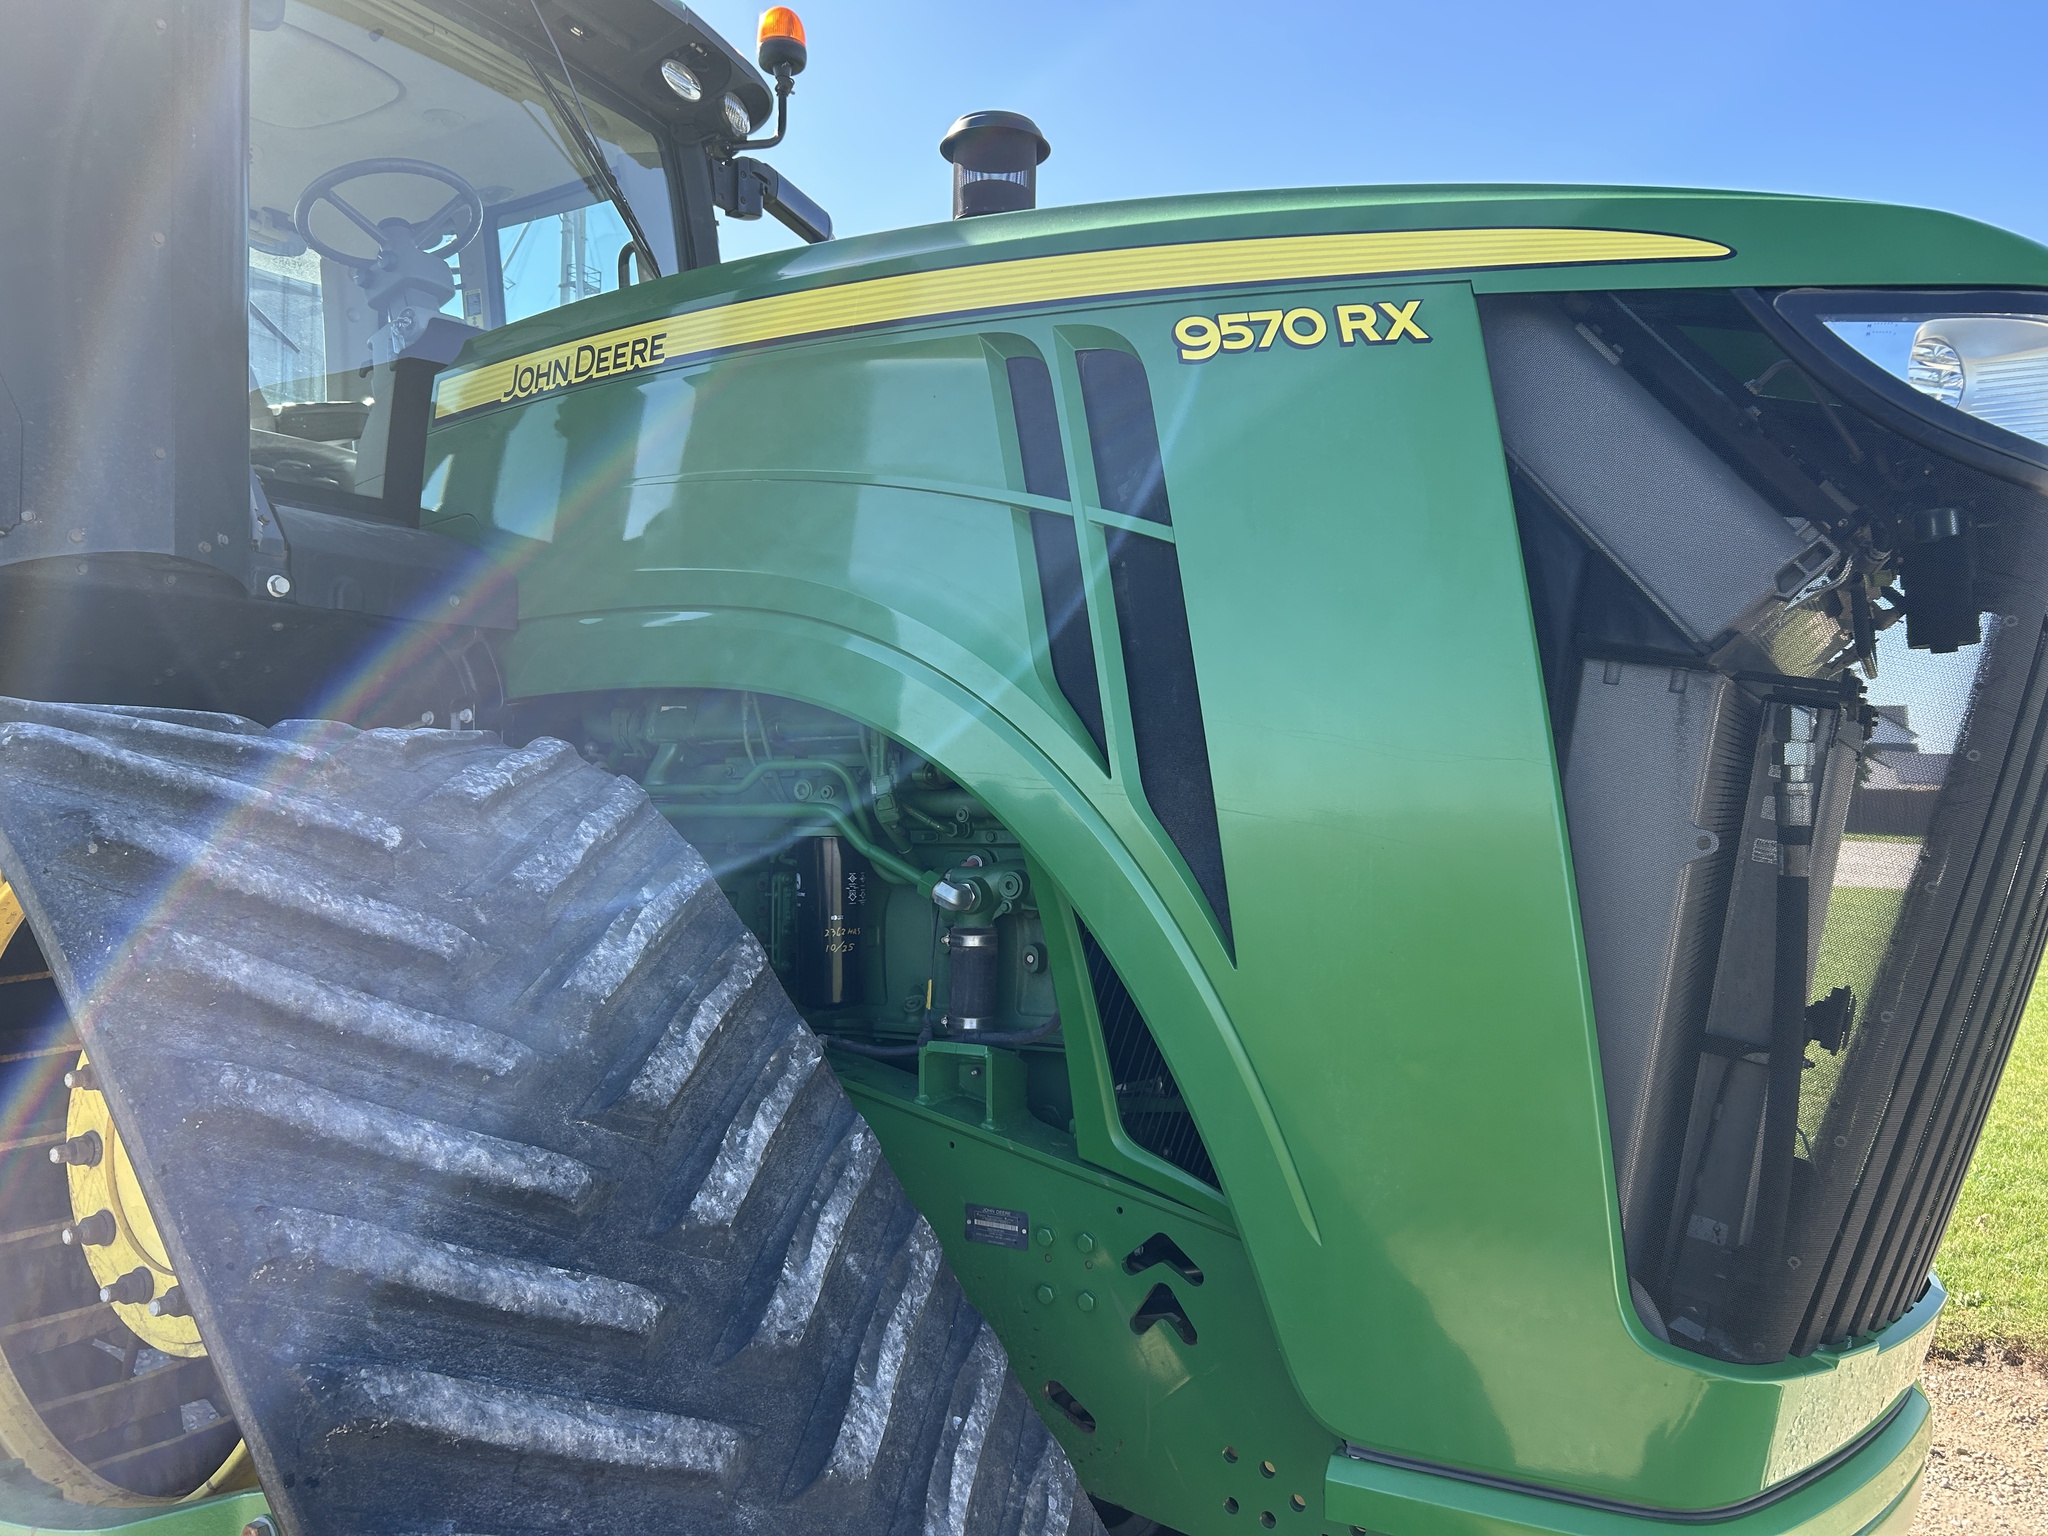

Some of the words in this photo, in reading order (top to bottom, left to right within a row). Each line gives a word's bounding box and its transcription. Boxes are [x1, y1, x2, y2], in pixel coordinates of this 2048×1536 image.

[1171, 307, 1327, 365] 9570
[1333, 299, 1433, 347] RX
[502, 356, 571, 401] JOHN
[574, 332, 668, 382] DEERE
[825, 940, 855, 953] 10/25
